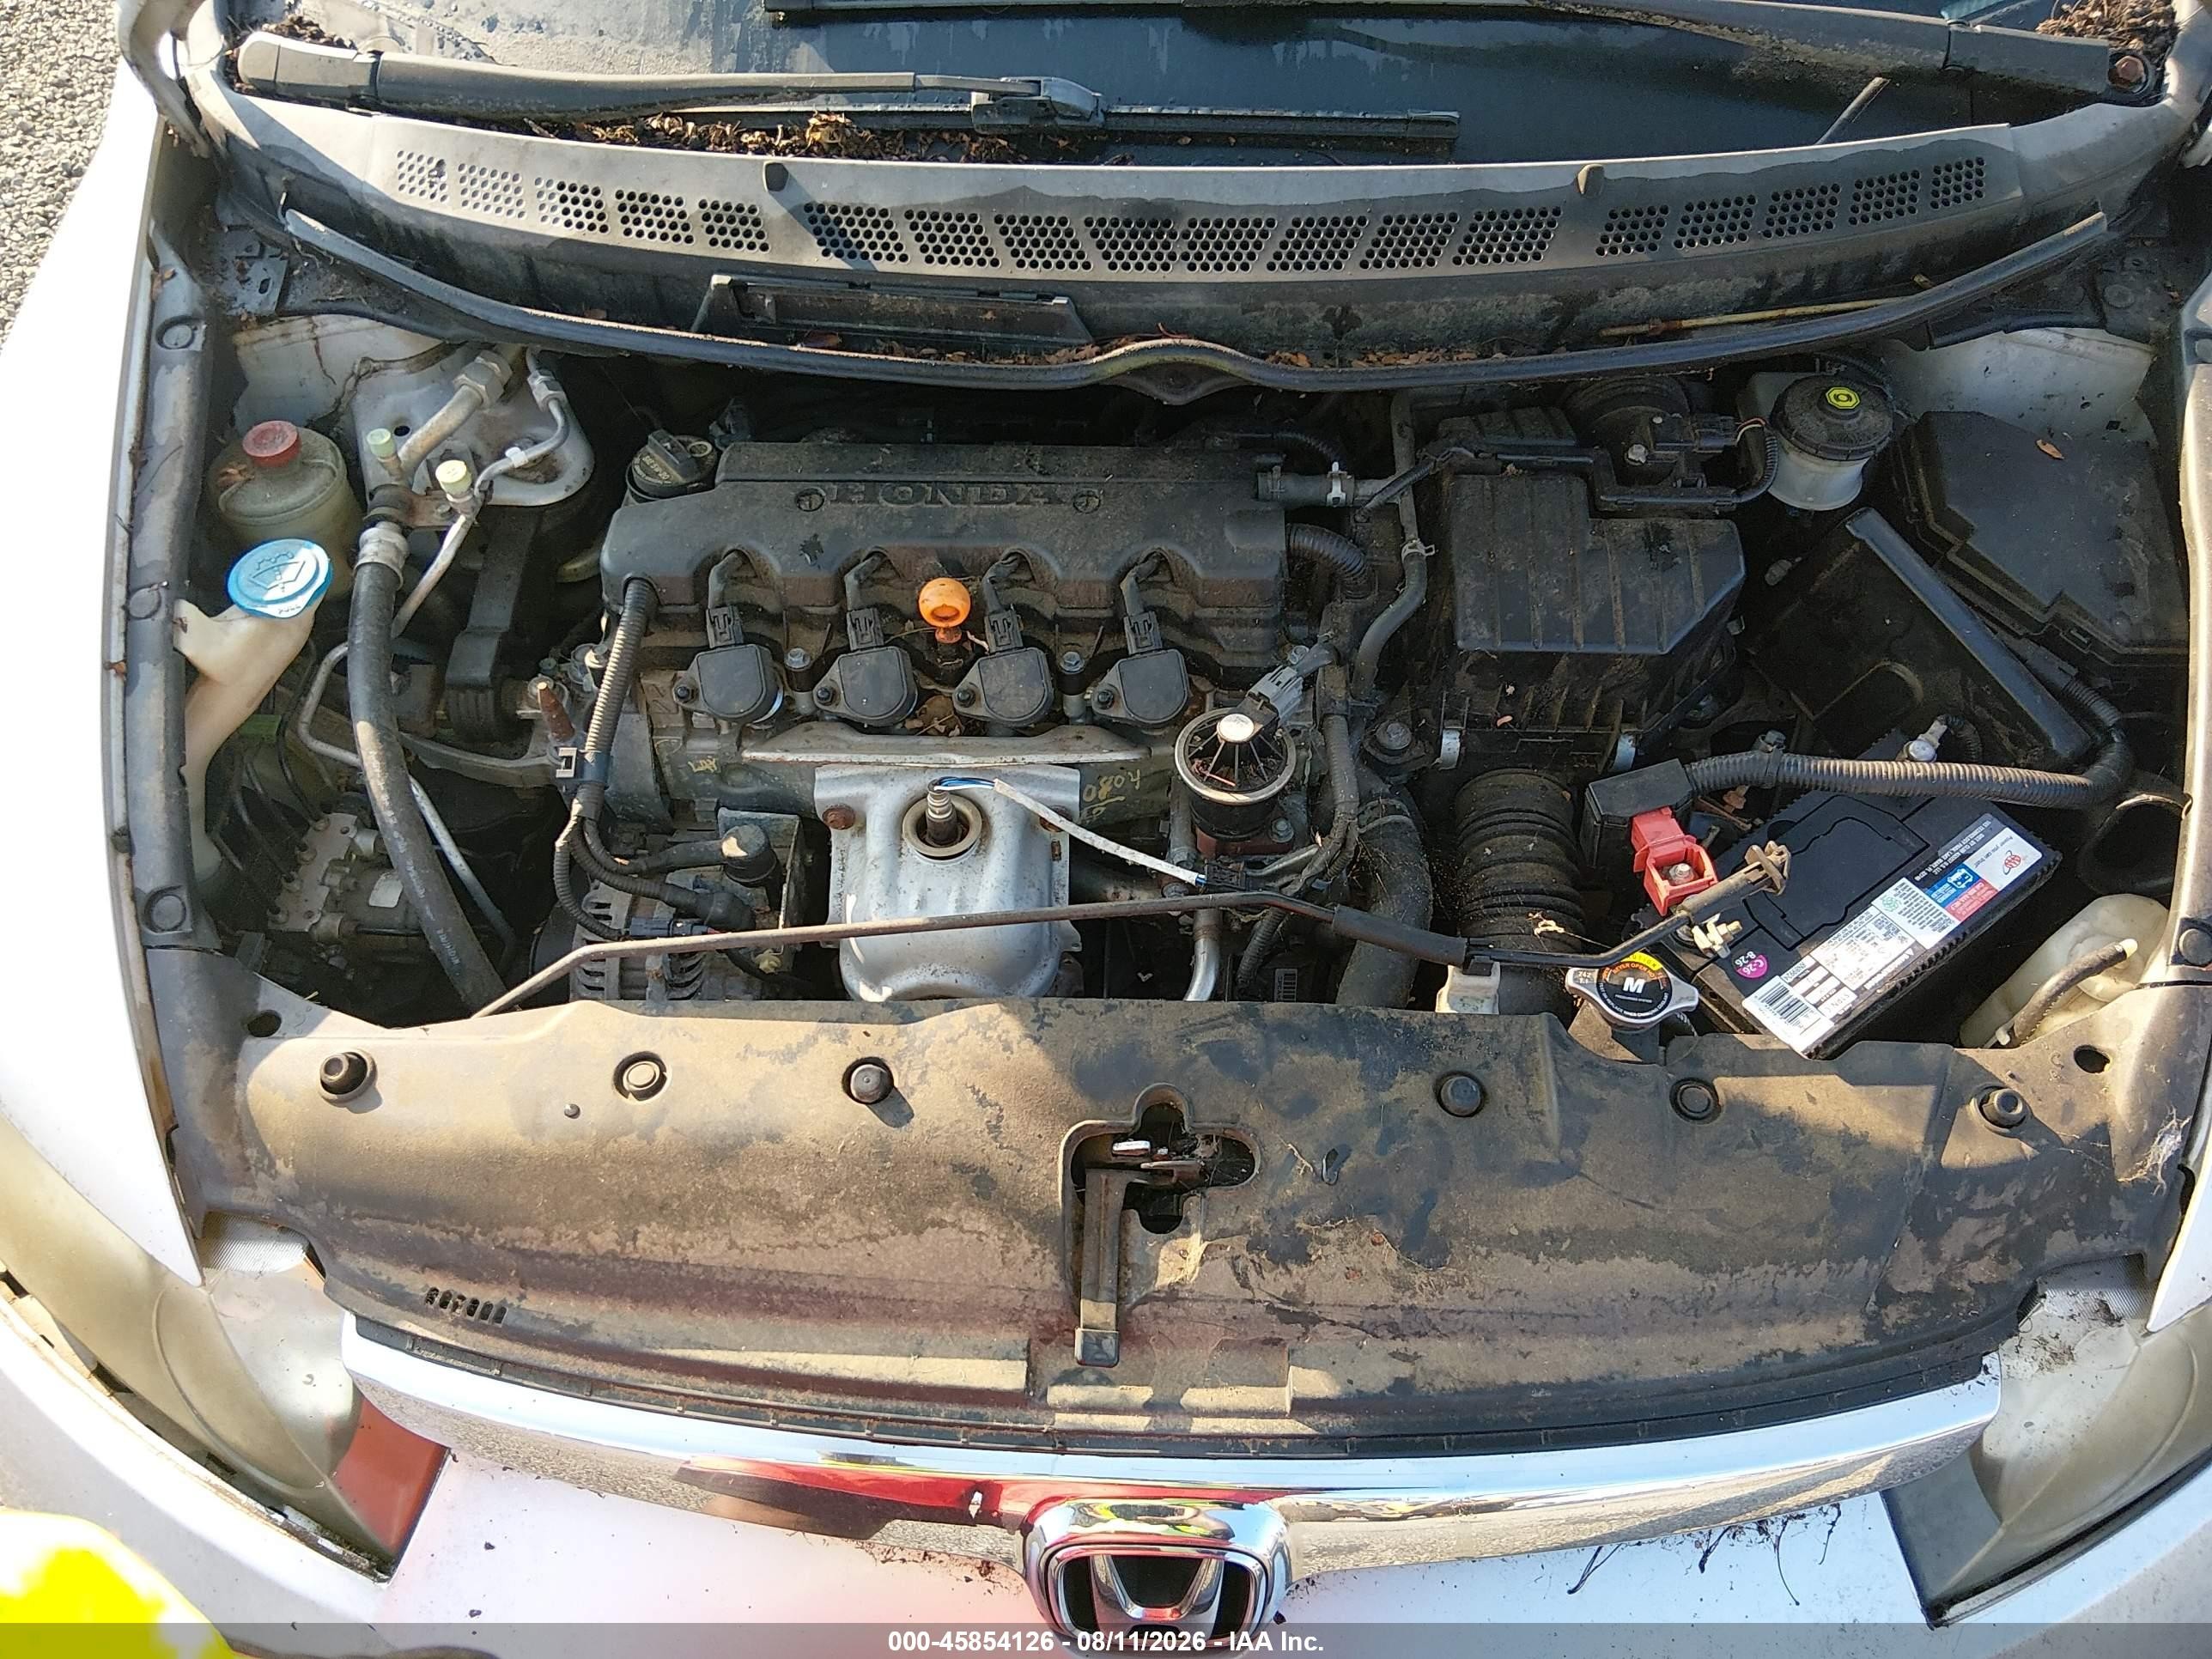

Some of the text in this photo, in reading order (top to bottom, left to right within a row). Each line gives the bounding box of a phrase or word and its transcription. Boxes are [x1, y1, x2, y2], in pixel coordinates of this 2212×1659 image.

[828, 481, 1061, 507] HONDA
[1735, 951, 1756, 966] 8-26
[1742, 958, 1764, 974] C-26
[1630, 963, 1648, 973] OPEN
[1622, 977, 1645, 994] M
